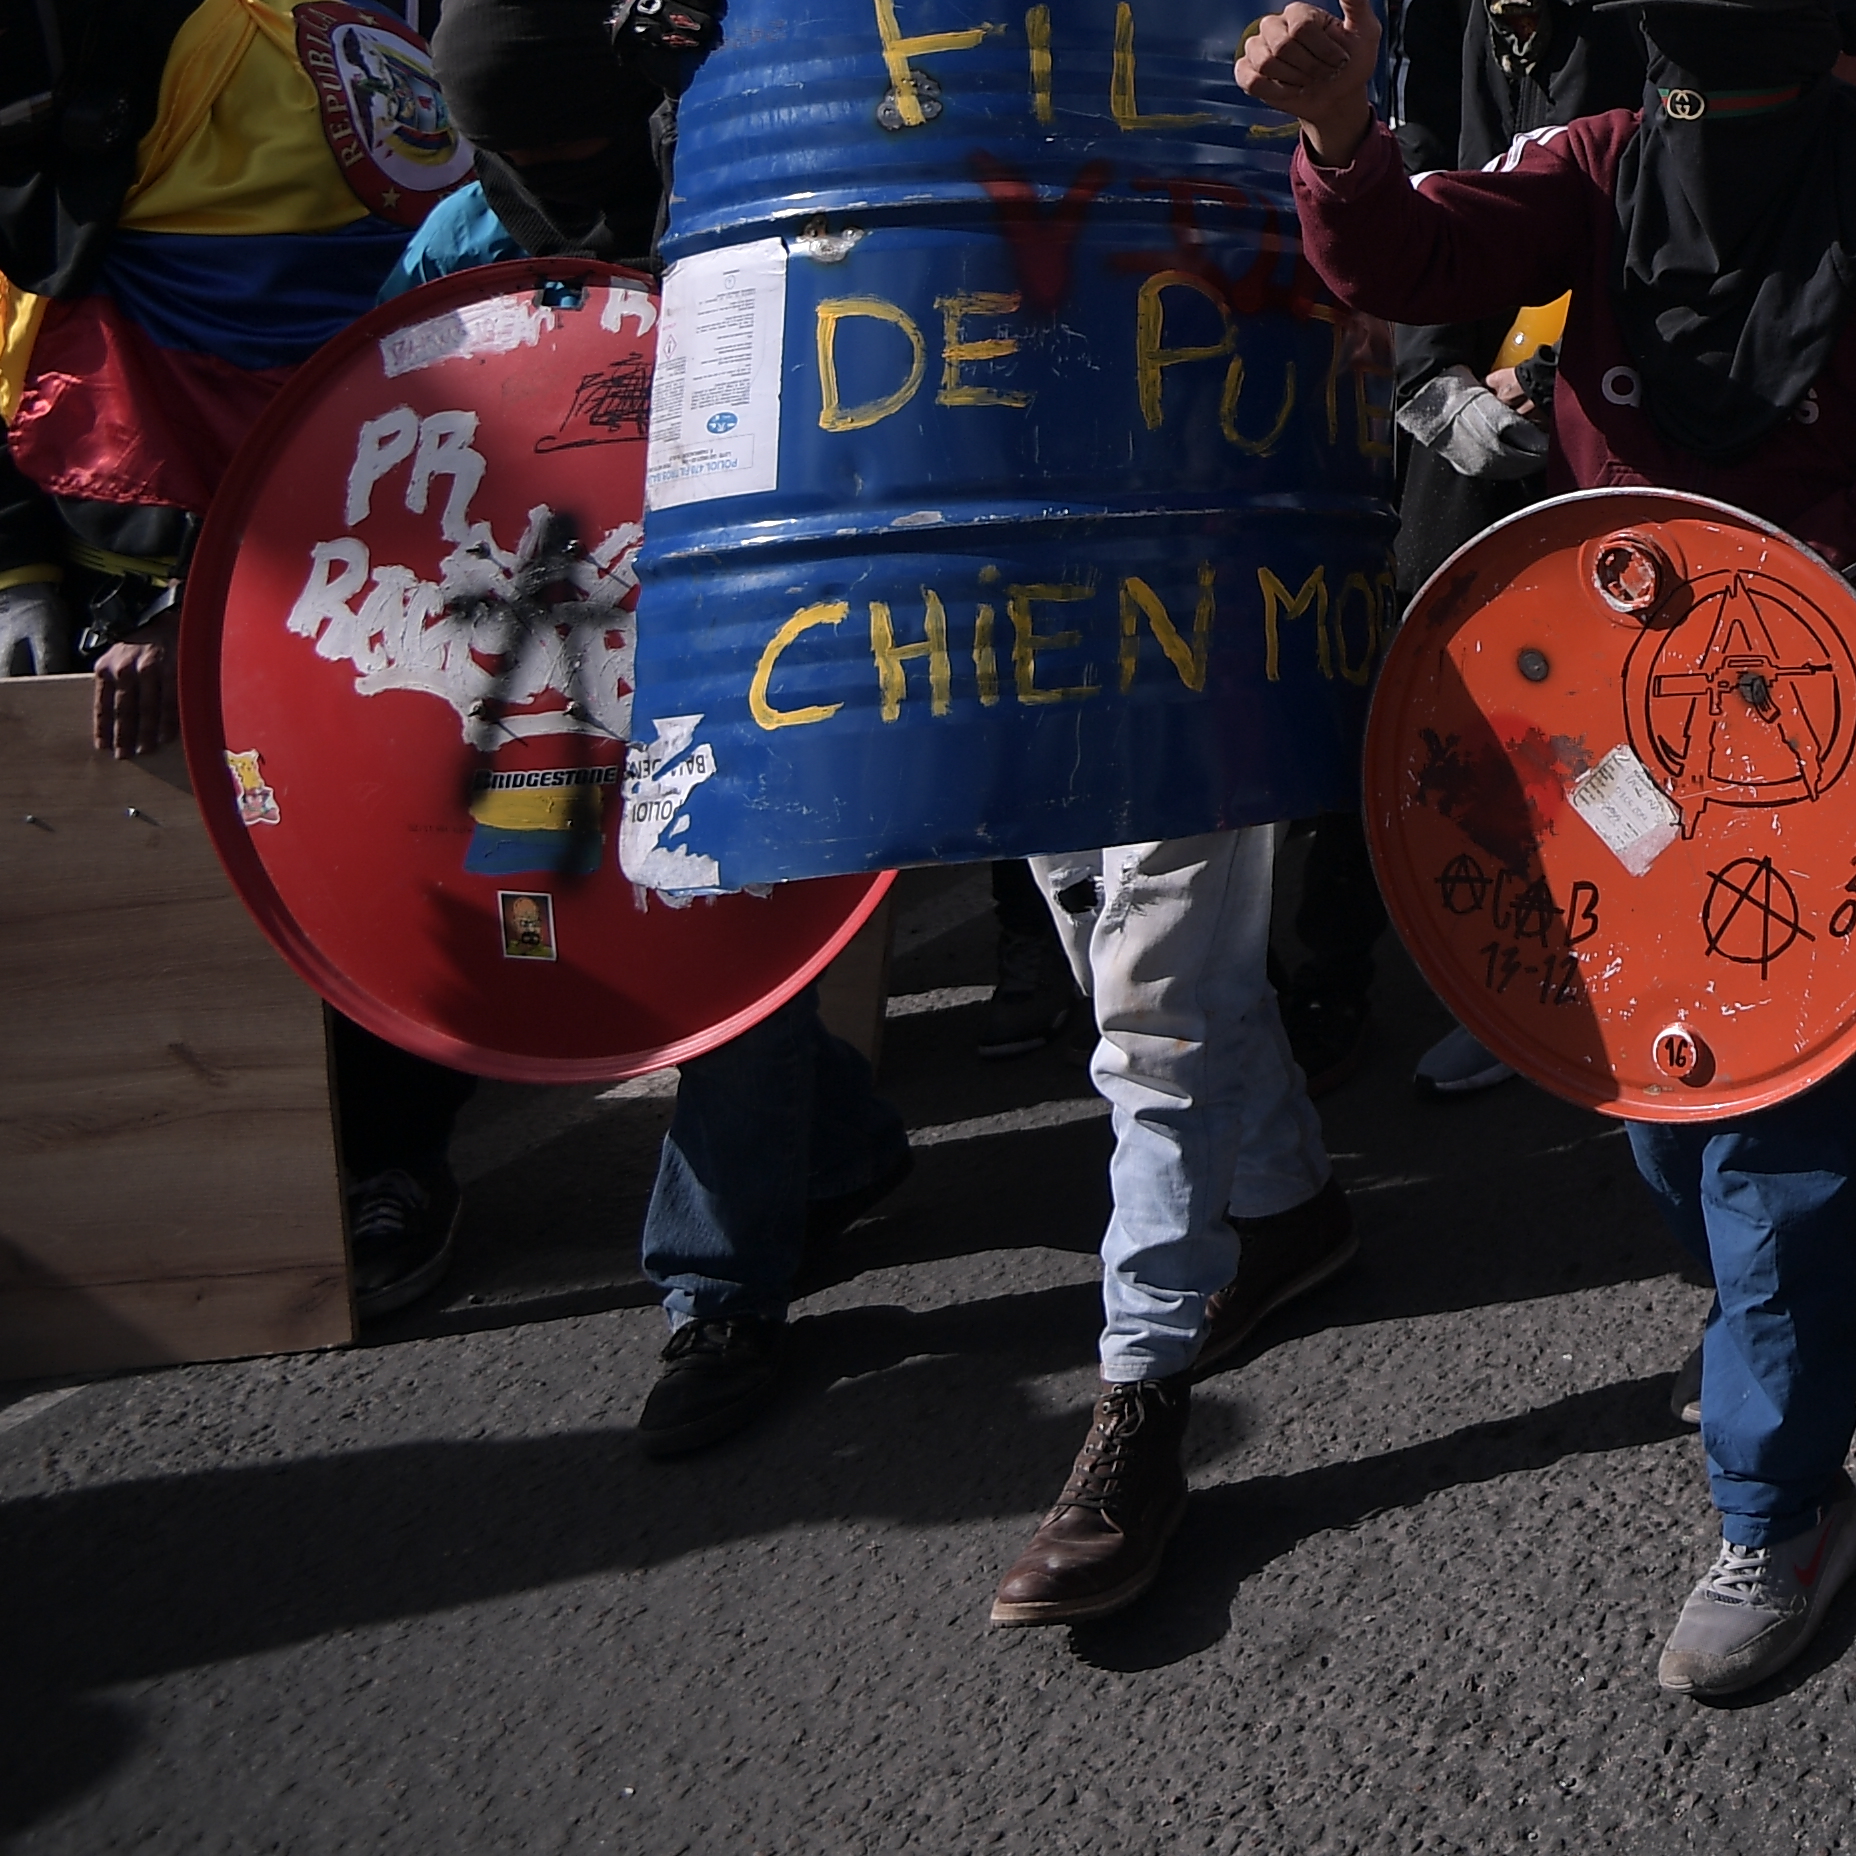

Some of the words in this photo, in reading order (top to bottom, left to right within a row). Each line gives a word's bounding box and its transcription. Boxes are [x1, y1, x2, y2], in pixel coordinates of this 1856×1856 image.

[815, 288, 1037, 433] DE
[1135, 267, 1394, 459] PUTE
[473, 765, 618, 792] BRIDGESTONE
